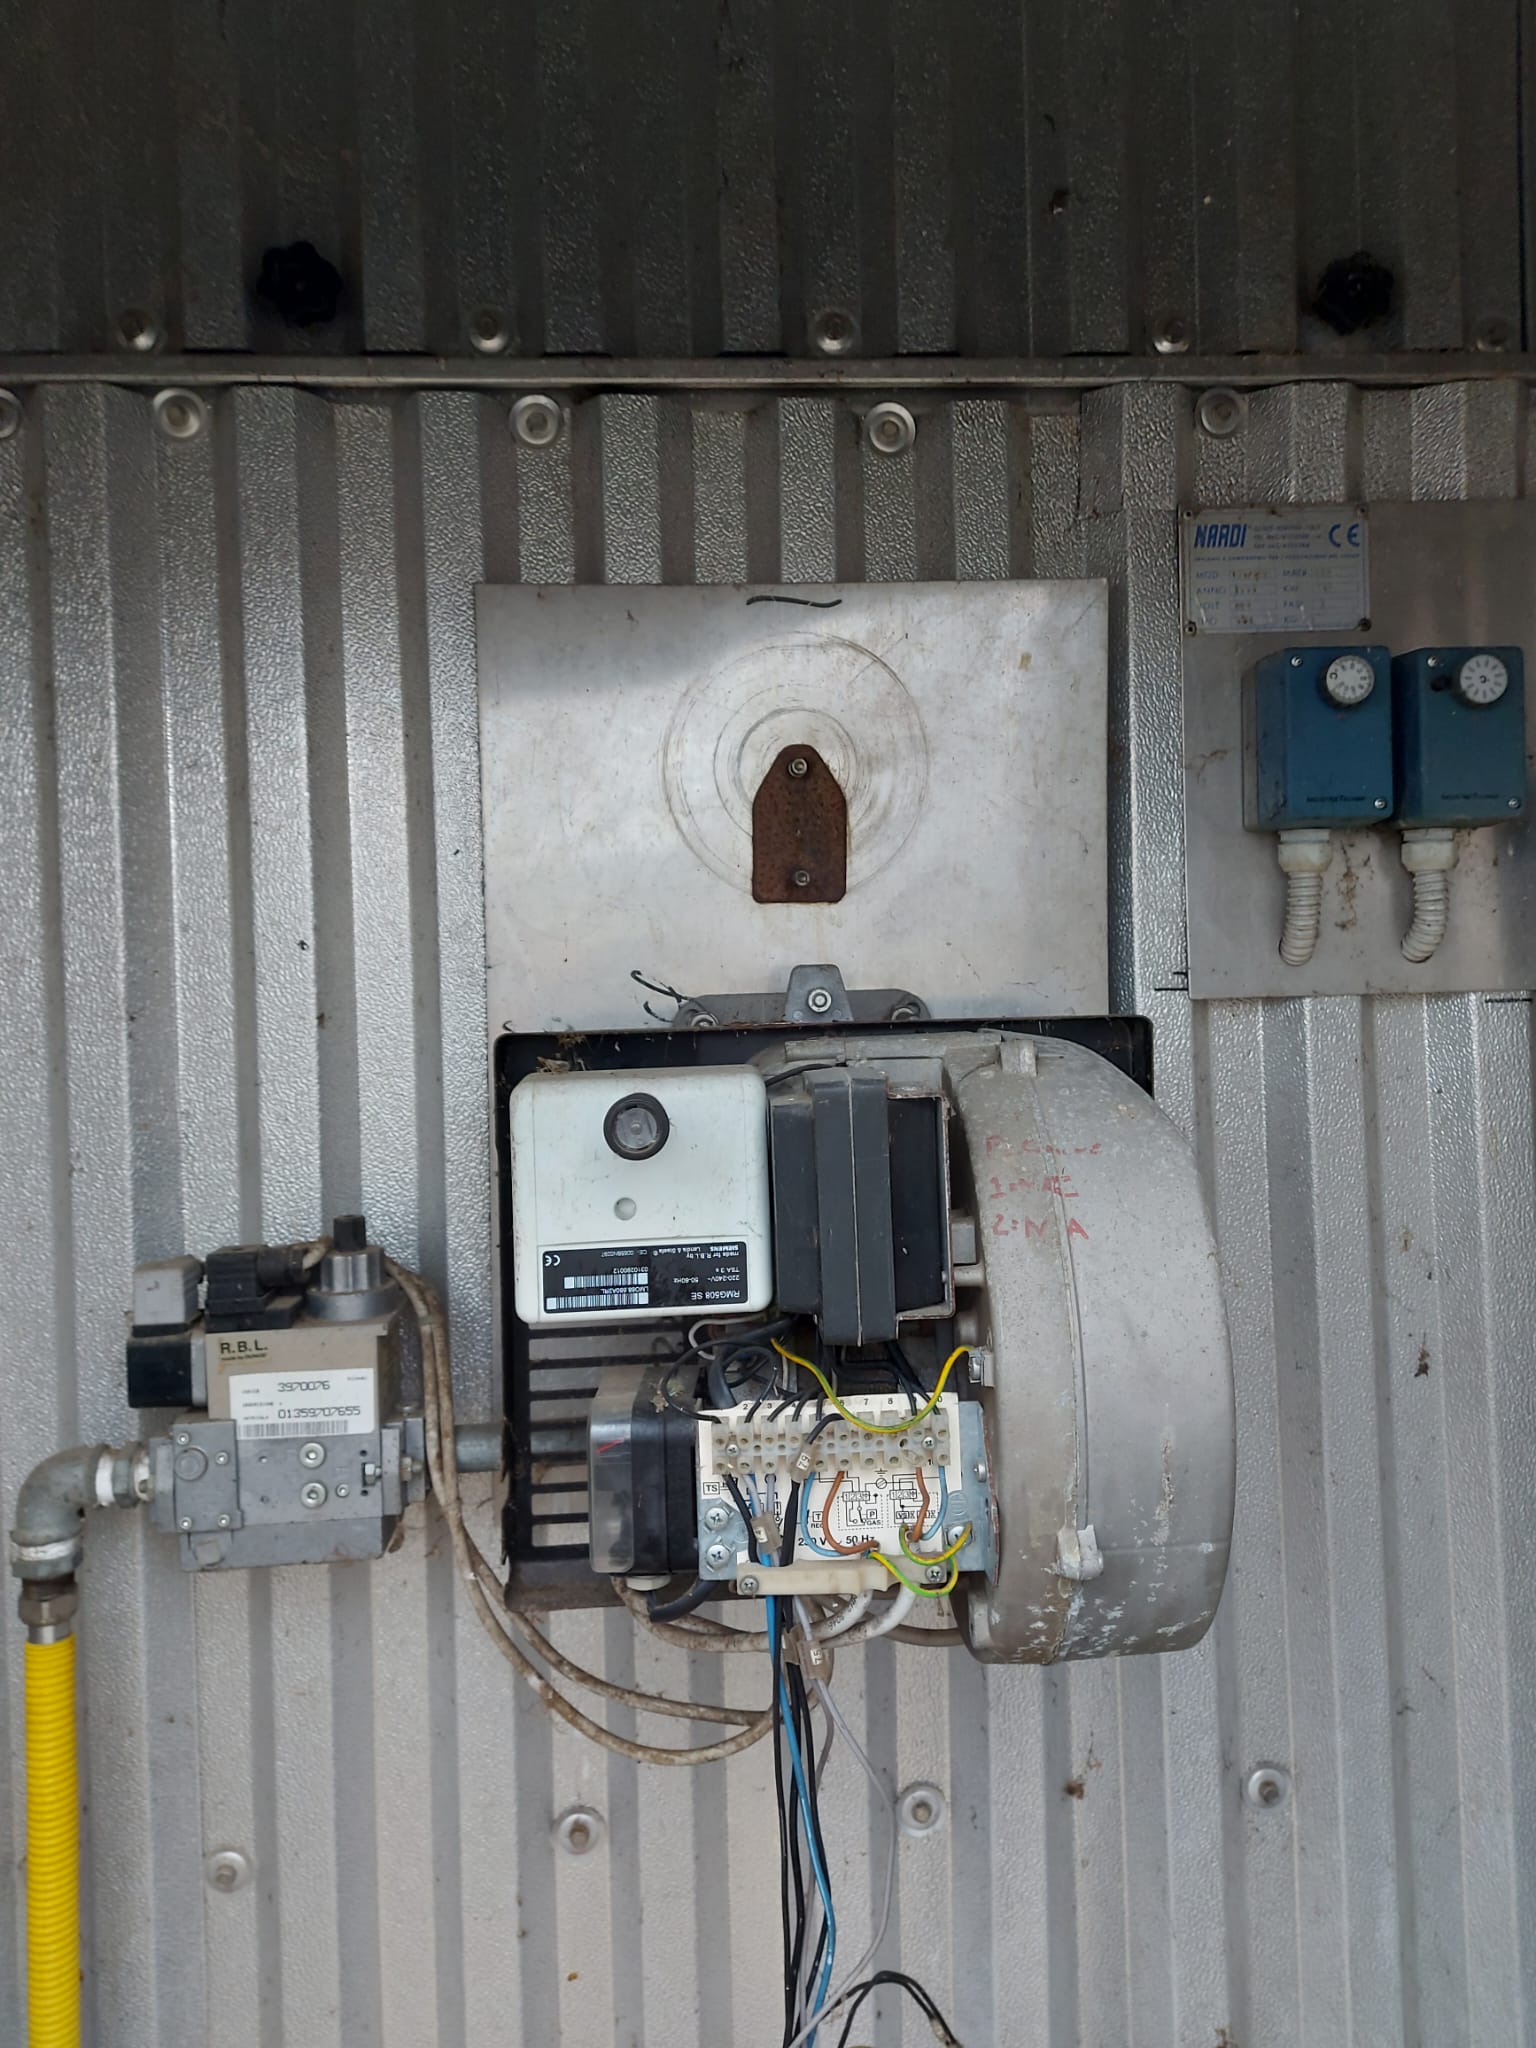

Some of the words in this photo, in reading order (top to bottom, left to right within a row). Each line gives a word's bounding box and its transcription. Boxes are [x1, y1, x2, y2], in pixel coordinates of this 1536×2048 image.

[1194, 523, 1247, 549] NARDI
[690, 1292, 704, 1300] SE
[705, 1290, 740, 1299] RMG508
[277, 1380, 331, 1393] 3970076
[277, 1405, 361, 1419] 01359707655
[706, 1484, 718, 1493] TS
[846, 1535, 859, 1544] 50
